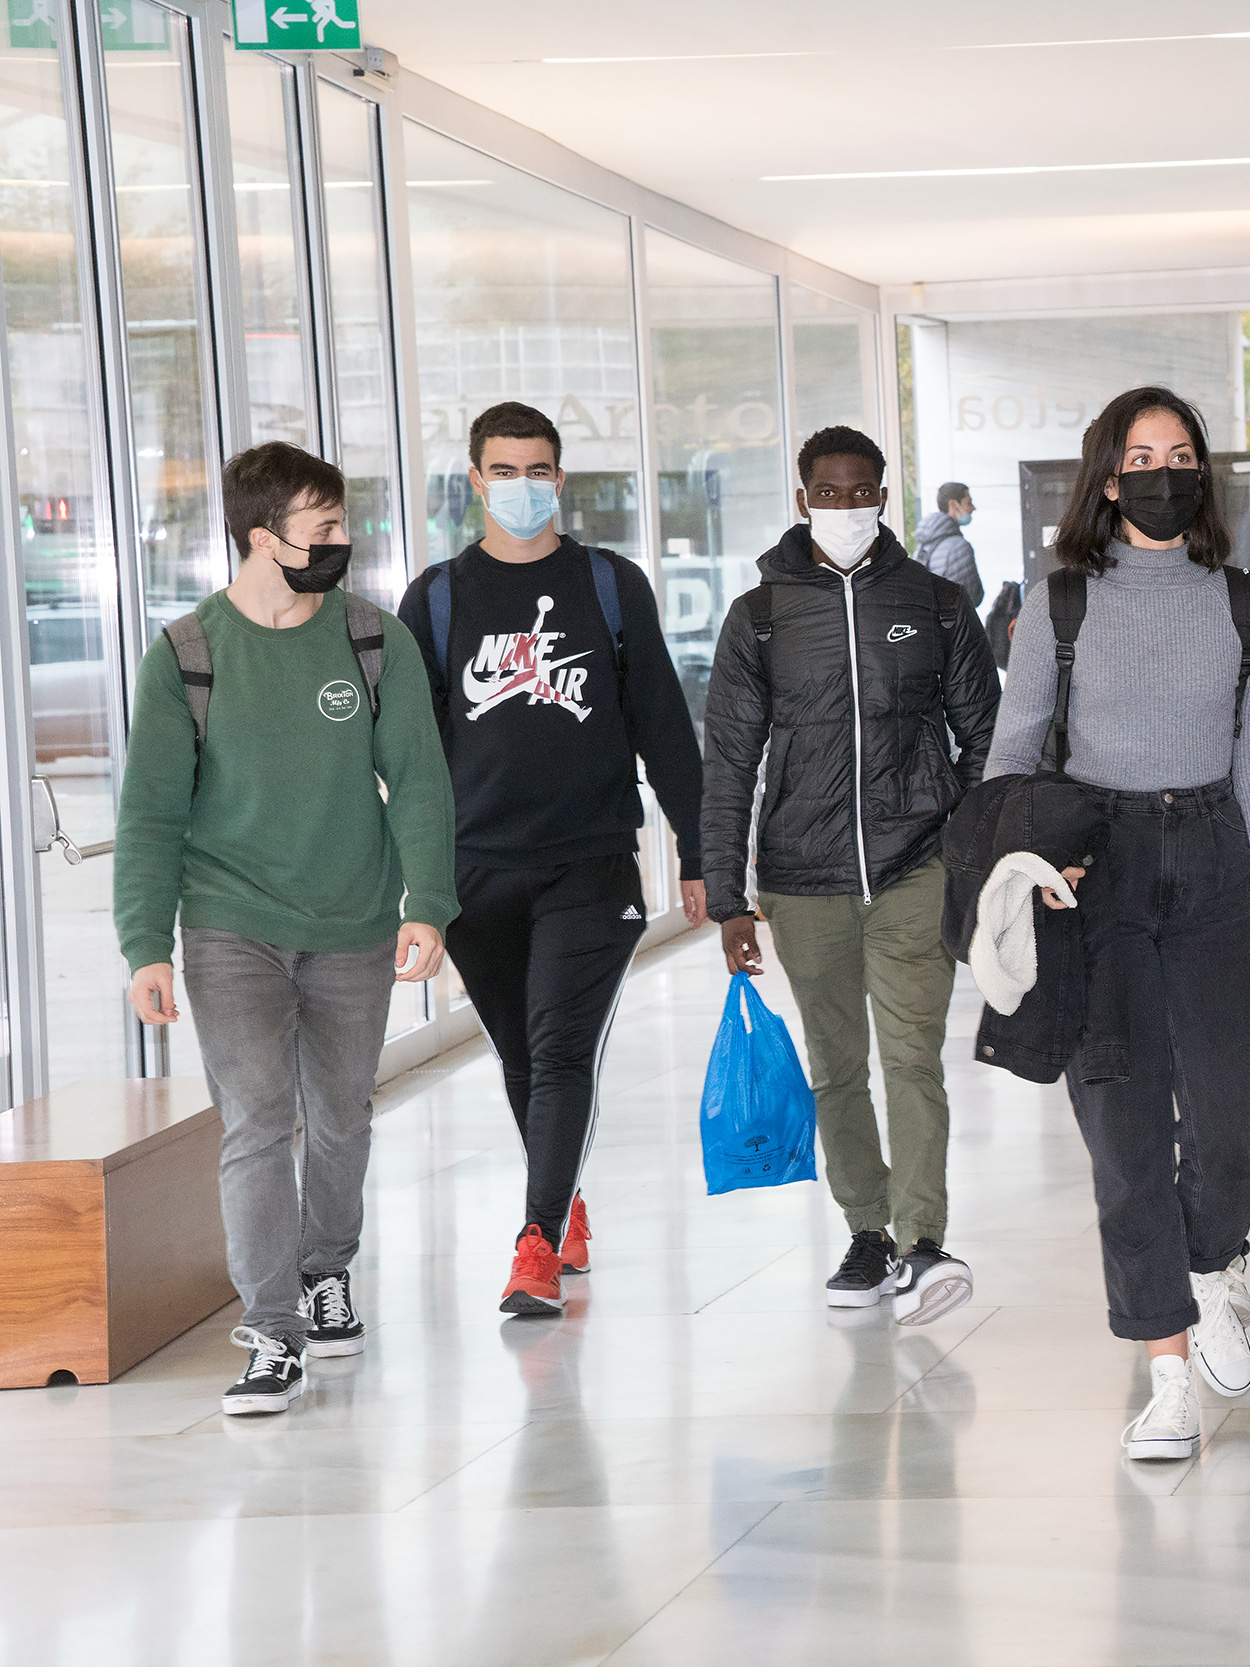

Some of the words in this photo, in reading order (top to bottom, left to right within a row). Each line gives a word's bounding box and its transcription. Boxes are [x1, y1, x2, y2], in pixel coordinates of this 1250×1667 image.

[893, 626, 910, 635] NIKE
[473, 632, 559, 673] NIKE
[528, 668, 588, 705] AIR
